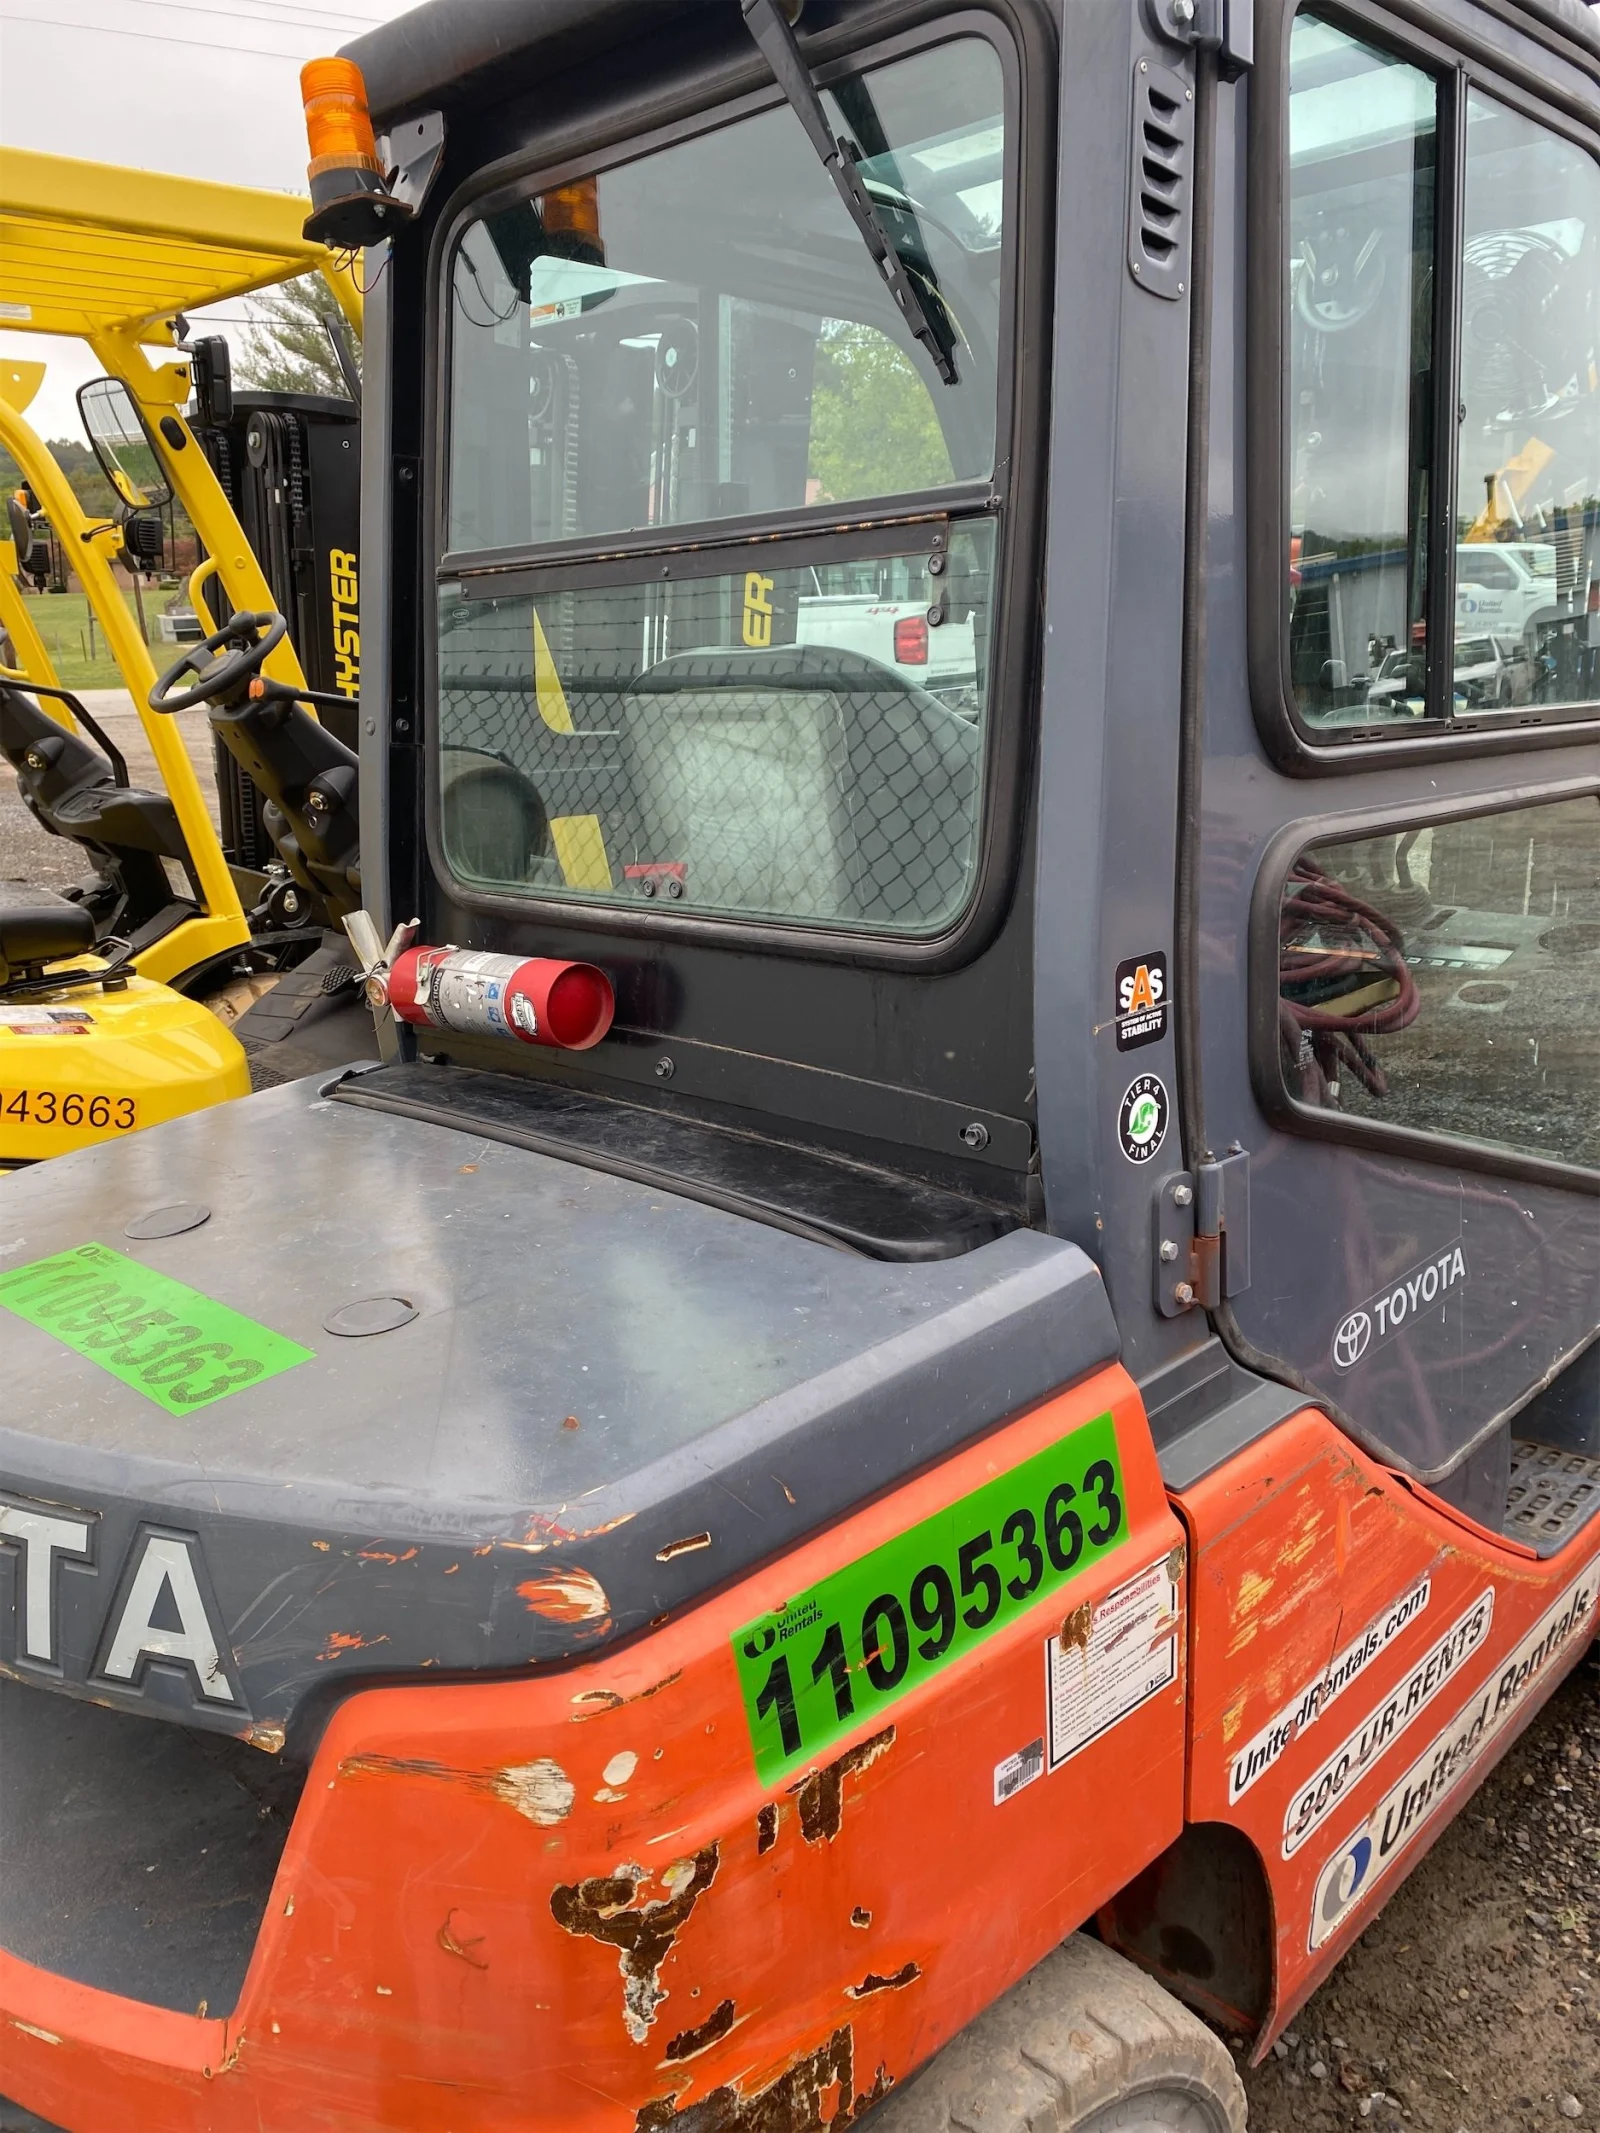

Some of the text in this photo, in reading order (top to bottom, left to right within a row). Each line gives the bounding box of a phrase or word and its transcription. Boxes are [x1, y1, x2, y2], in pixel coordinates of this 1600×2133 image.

[1120, 964, 1163, 1013] SAS
[1121, 1017, 1163, 1040] STABILITY
[0, 1090, 136, 1130] 43663
[1128, 1129, 1164, 1159] FINAL
[1374, 1246, 1466, 1336] TOYOTA
[755, 1459, 1122, 1758] 11095363
[777, 1598, 817, 1630] United
[779, 1609, 824, 1643] Rentals
[1234, 1583, 1429, 1793] UnitedRentals.com
[1380, 1693, 1491, 1857] United
